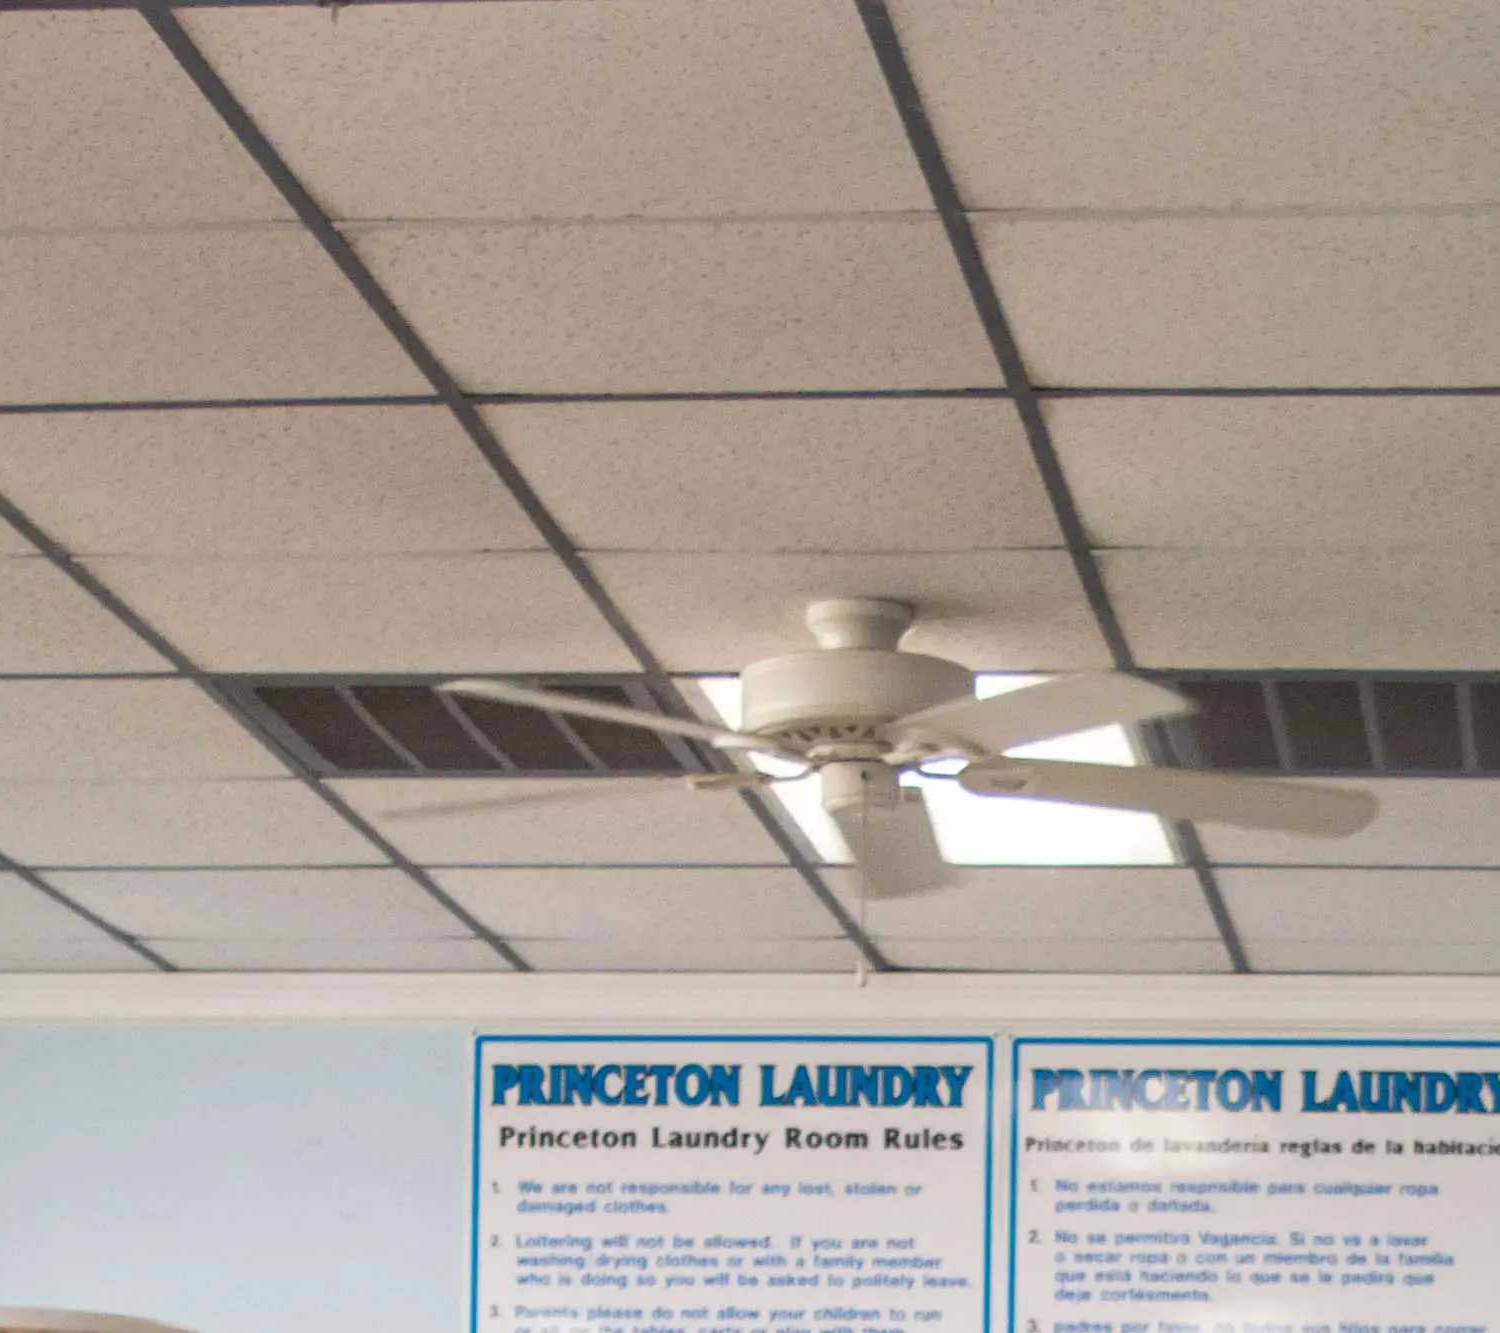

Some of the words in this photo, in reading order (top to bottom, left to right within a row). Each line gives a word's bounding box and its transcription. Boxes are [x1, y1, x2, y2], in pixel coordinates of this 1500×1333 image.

[492, 1063, 741, 1105] PRINCETON
[759, 1064, 973, 1106] LAUNDRY
[1030, 1068, 1284, 1109] PRINCETON
[497, 1126, 638, 1148] Princeton
[649, 1125, 771, 1153] Laundry
[782, 1125, 871, 1149] Room
[881, 1125, 965, 1150] Rules
[1023, 1138, 1121, 1153] Princeton
[1278, 1141, 1343, 1157] reglas
